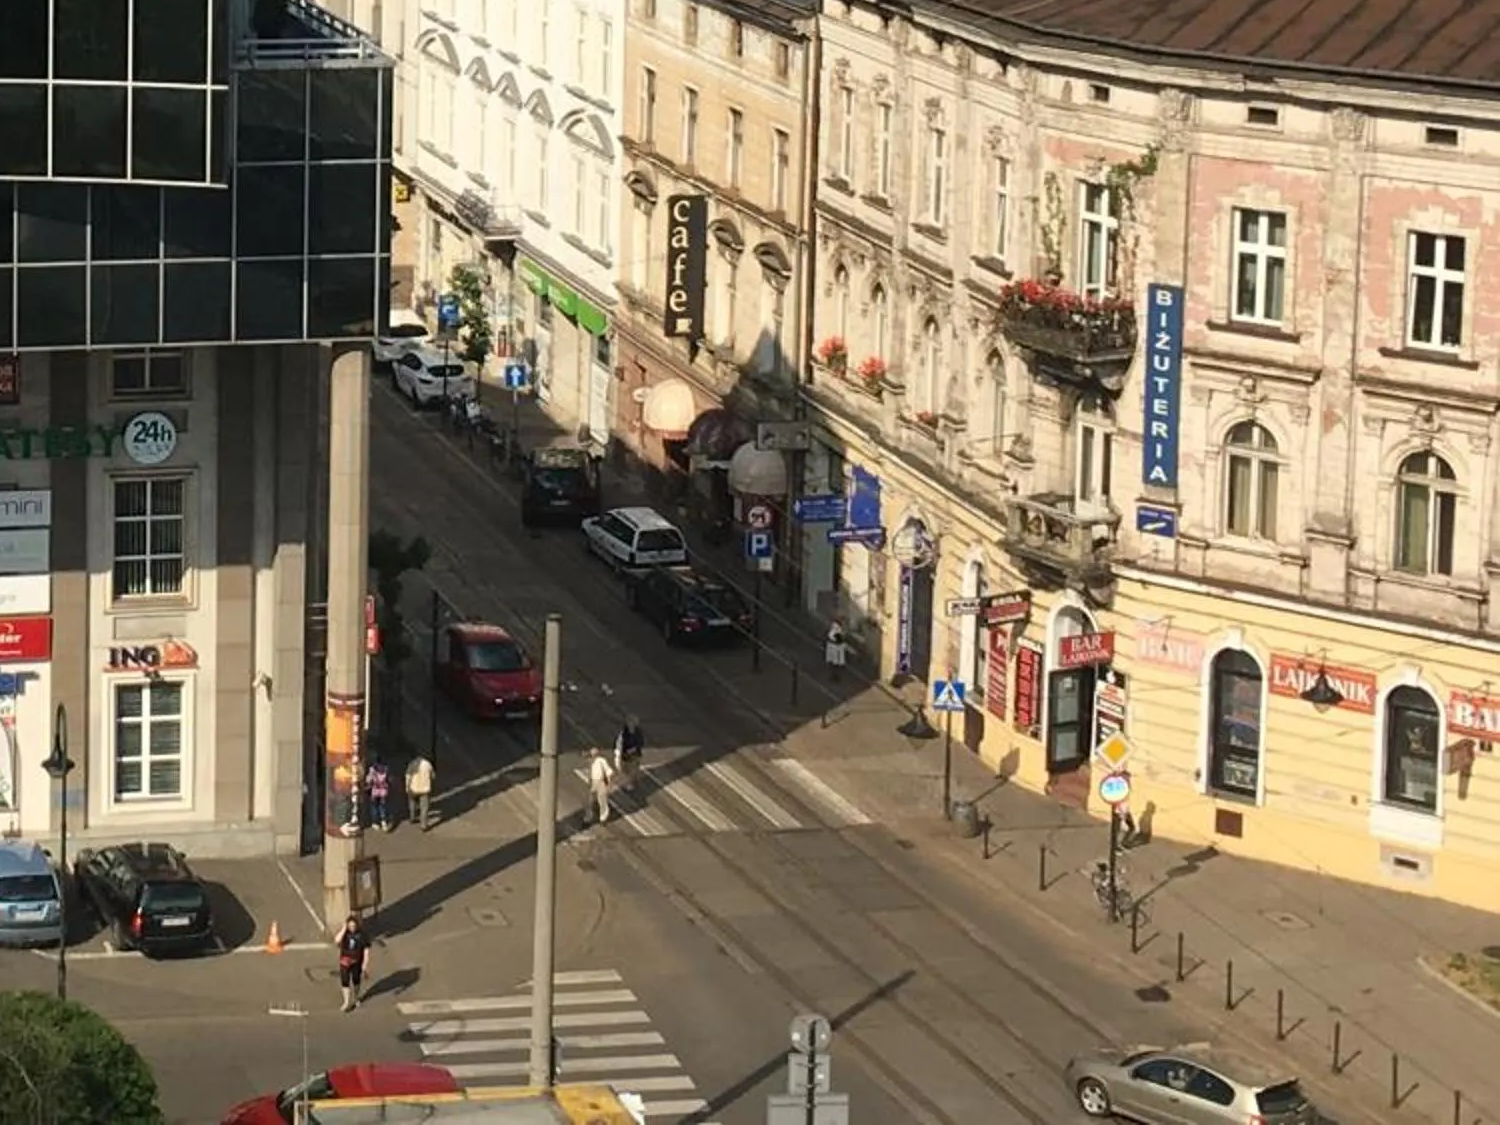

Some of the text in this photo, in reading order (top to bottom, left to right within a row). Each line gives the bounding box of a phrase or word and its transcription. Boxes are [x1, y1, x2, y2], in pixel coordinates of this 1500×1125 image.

[669, 200, 691, 312] cafe
[1149, 289, 1173, 483] BIŻUTERIA
[132, 420, 172, 443] 24h
[752, 534, 767, 555] P
[1071, 635, 1102, 653] BAR
[110, 645, 160, 668] ING
[1453, 701, 1500, 732] BA
